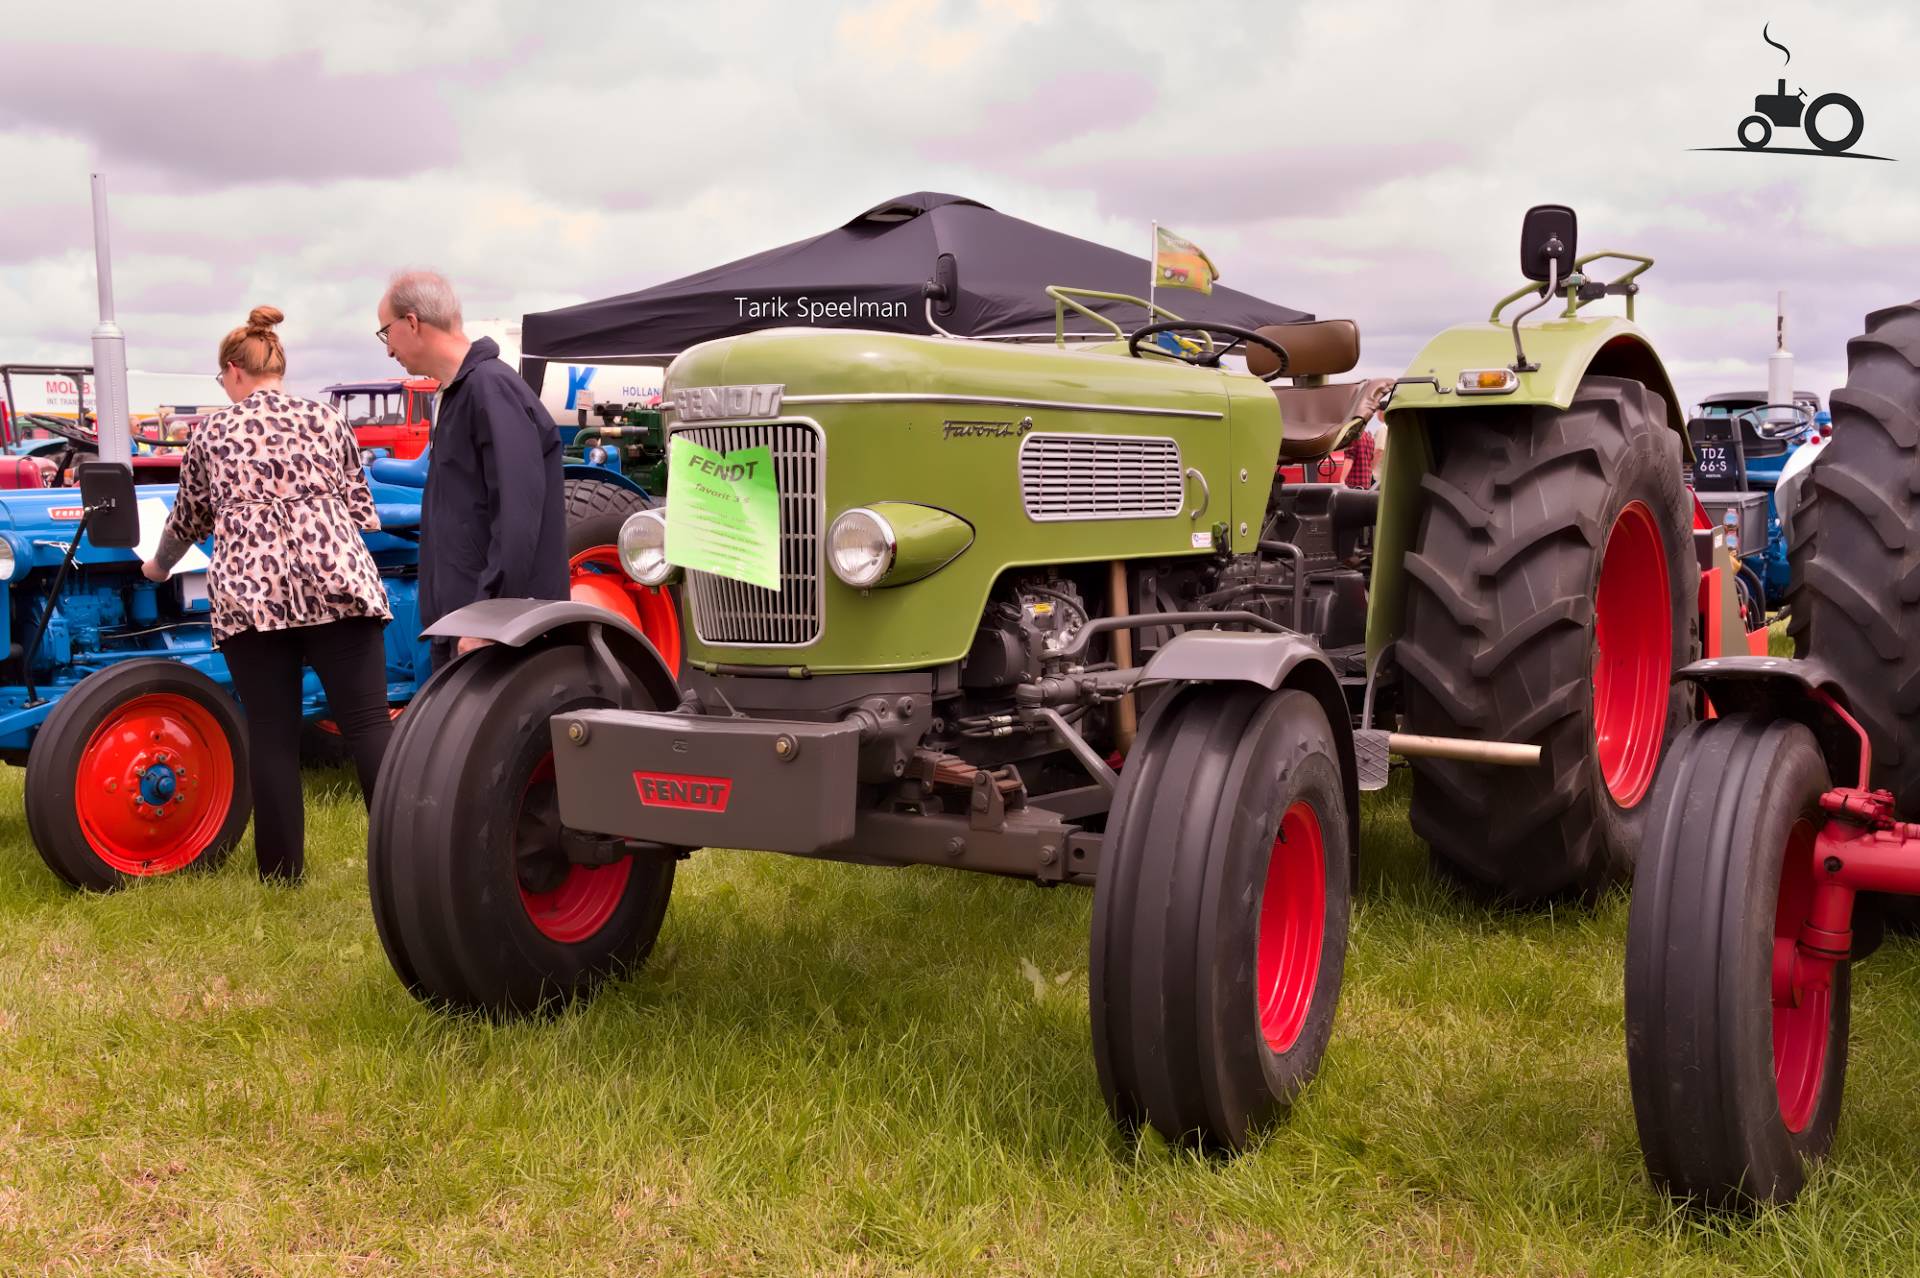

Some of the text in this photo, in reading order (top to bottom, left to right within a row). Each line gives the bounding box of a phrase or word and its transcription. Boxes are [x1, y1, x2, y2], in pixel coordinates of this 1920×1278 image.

[46, 381, 77, 394] MOL
[622, 386, 661, 397] HOLLAN
[673, 386, 783, 420] FENDT
[1700, 447, 1726, 459] TDZ
[688, 455, 760, 482] FENDT
[695, 483, 732, 501] favorit
[640, 777, 728, 806] FENDT
